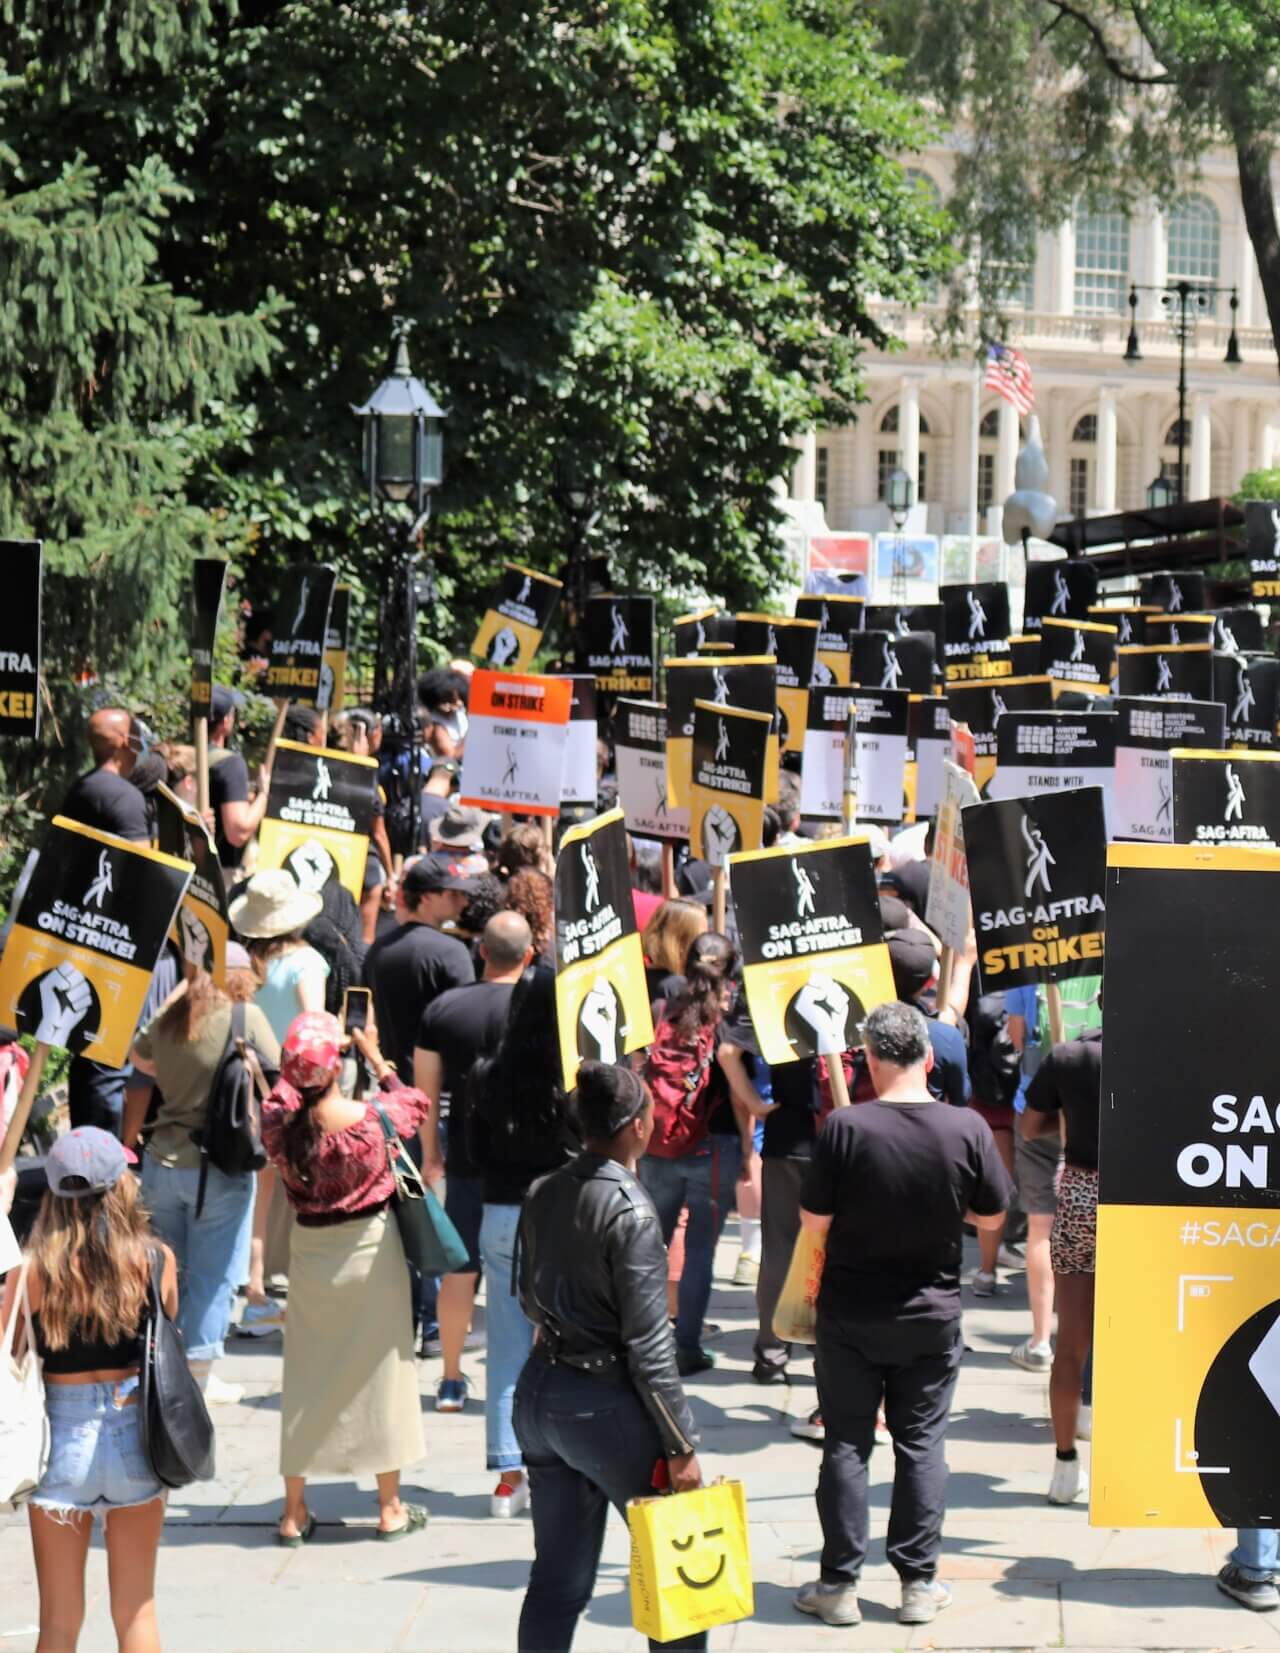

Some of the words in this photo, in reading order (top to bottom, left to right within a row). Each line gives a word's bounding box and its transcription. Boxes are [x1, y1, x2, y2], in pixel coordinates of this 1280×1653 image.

[1141, 757, 1169, 769] STANDS
[1028, 776, 1060, 787] STANDS
[1064, 776, 1084, 787] WITH
[280, 806, 303, 823] ON
[37, 911, 65, 934] ON
[65, 924, 138, 960] STRIKE!
[1032, 926, 1059, 940] ON
[761, 939, 793, 959] ON
[795, 927, 863, 953] STRIKE!
[1176, 1143, 1268, 1188] ON
